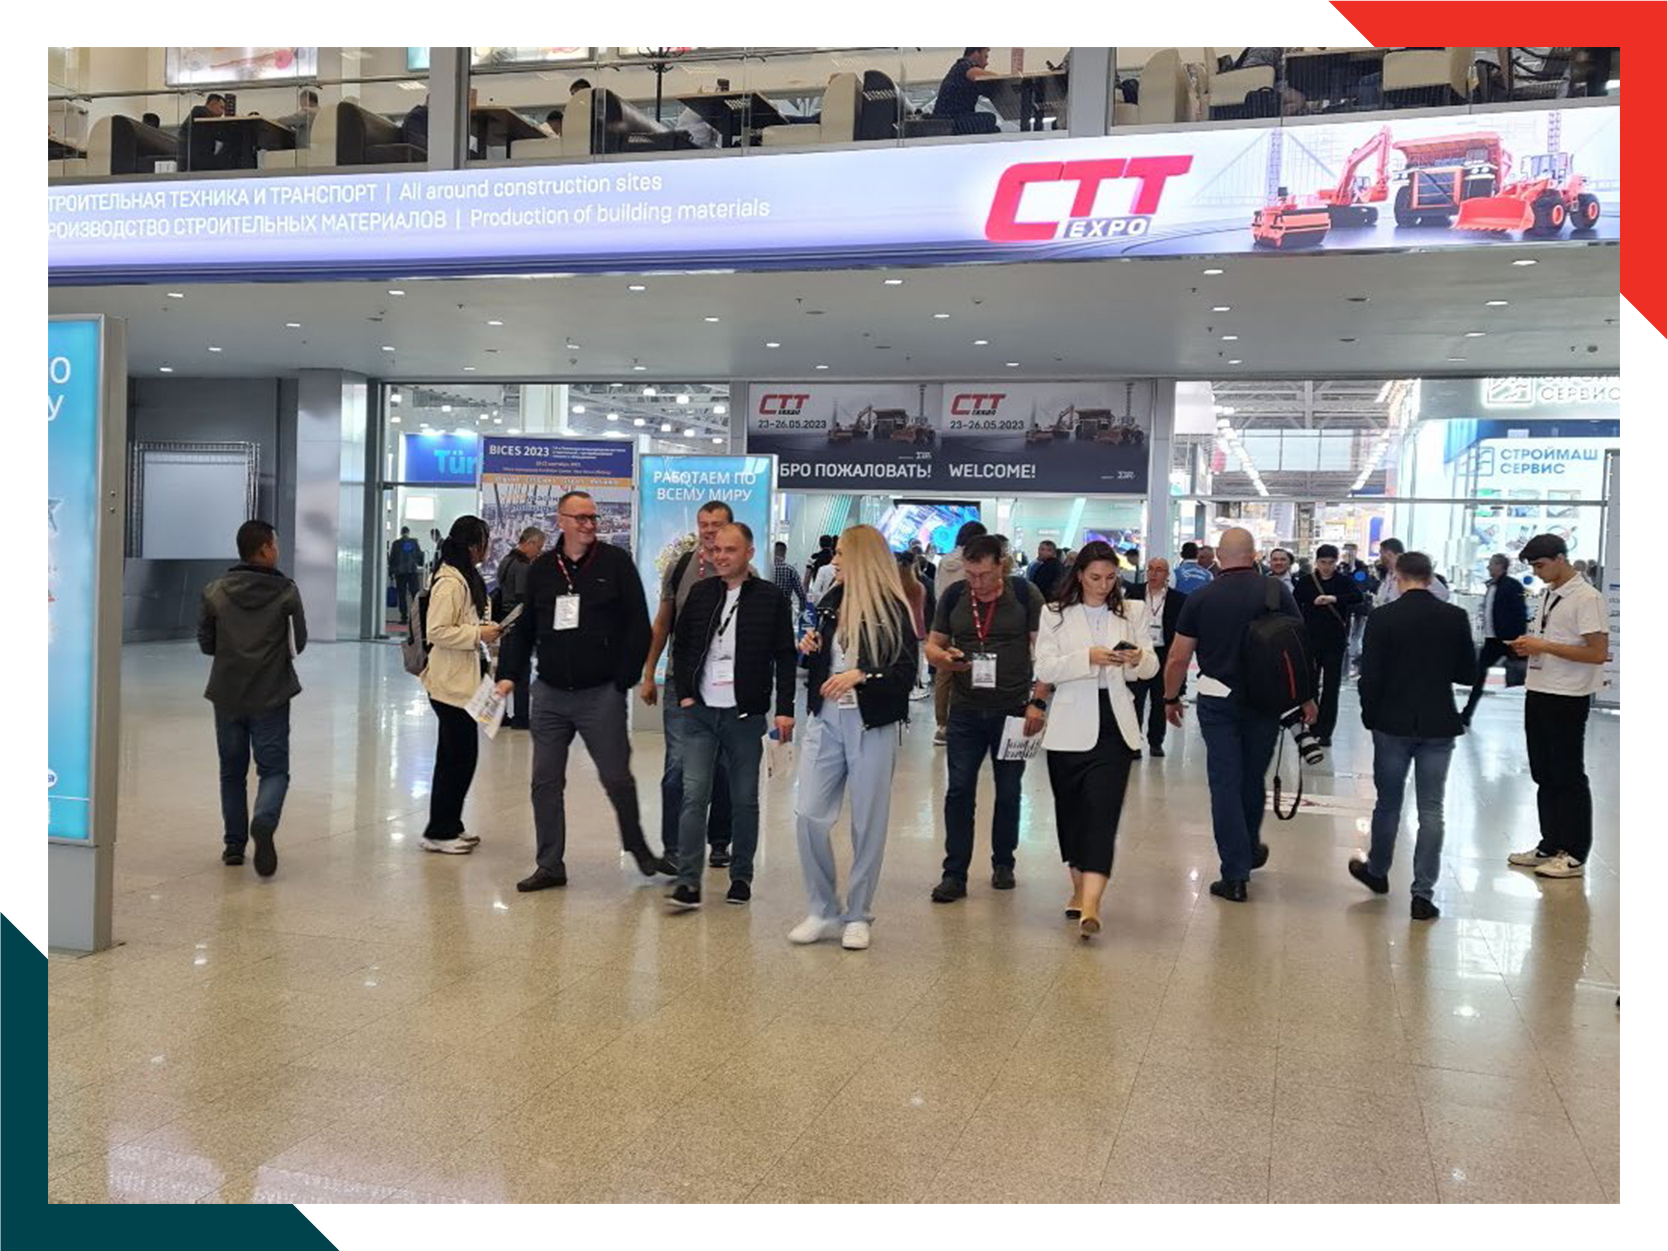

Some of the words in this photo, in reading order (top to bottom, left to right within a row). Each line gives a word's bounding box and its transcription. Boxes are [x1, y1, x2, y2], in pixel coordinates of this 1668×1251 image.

[169, 188, 249, 208] ТЕХНИКА
[253, 187, 266, 205] И
[269, 184, 377, 205] ТРАНСПОРТ
[399, 182, 422, 200] All
[426, 180, 489, 200] around
[494, 174, 611, 197] construction
[616, 172, 663, 192] sites
[174, 214, 317, 235] СТРОИТЕЛЬНЫХ
[322, 209, 446, 231] МАТЕРИАЛОВ
[471, 206, 571, 228] Production
[574, 203, 592, 223] of
[597, 201, 672, 223] building
[677, 198, 770, 219] materials
[1069, 218, 1147, 238] EXPO
[489, 444, 522, 456] BICES
[523, 446, 550, 457] 2023
[1500, 446, 1598, 460] СТРОЙМАШ
[780, 463, 811, 477] БРО
[815, 463, 932, 478] ПОЖАЛОВАТЬ!
[949, 463, 1036, 479] WELCOME!
[1500, 463, 1566, 475] СЕРВИС
[653, 471, 730, 485] РАБОТАЕМ
[734, 472, 756, 485] ПО
[656, 488, 706, 501] ВСЕМУ
[708, 489, 752, 501] МИРУ
